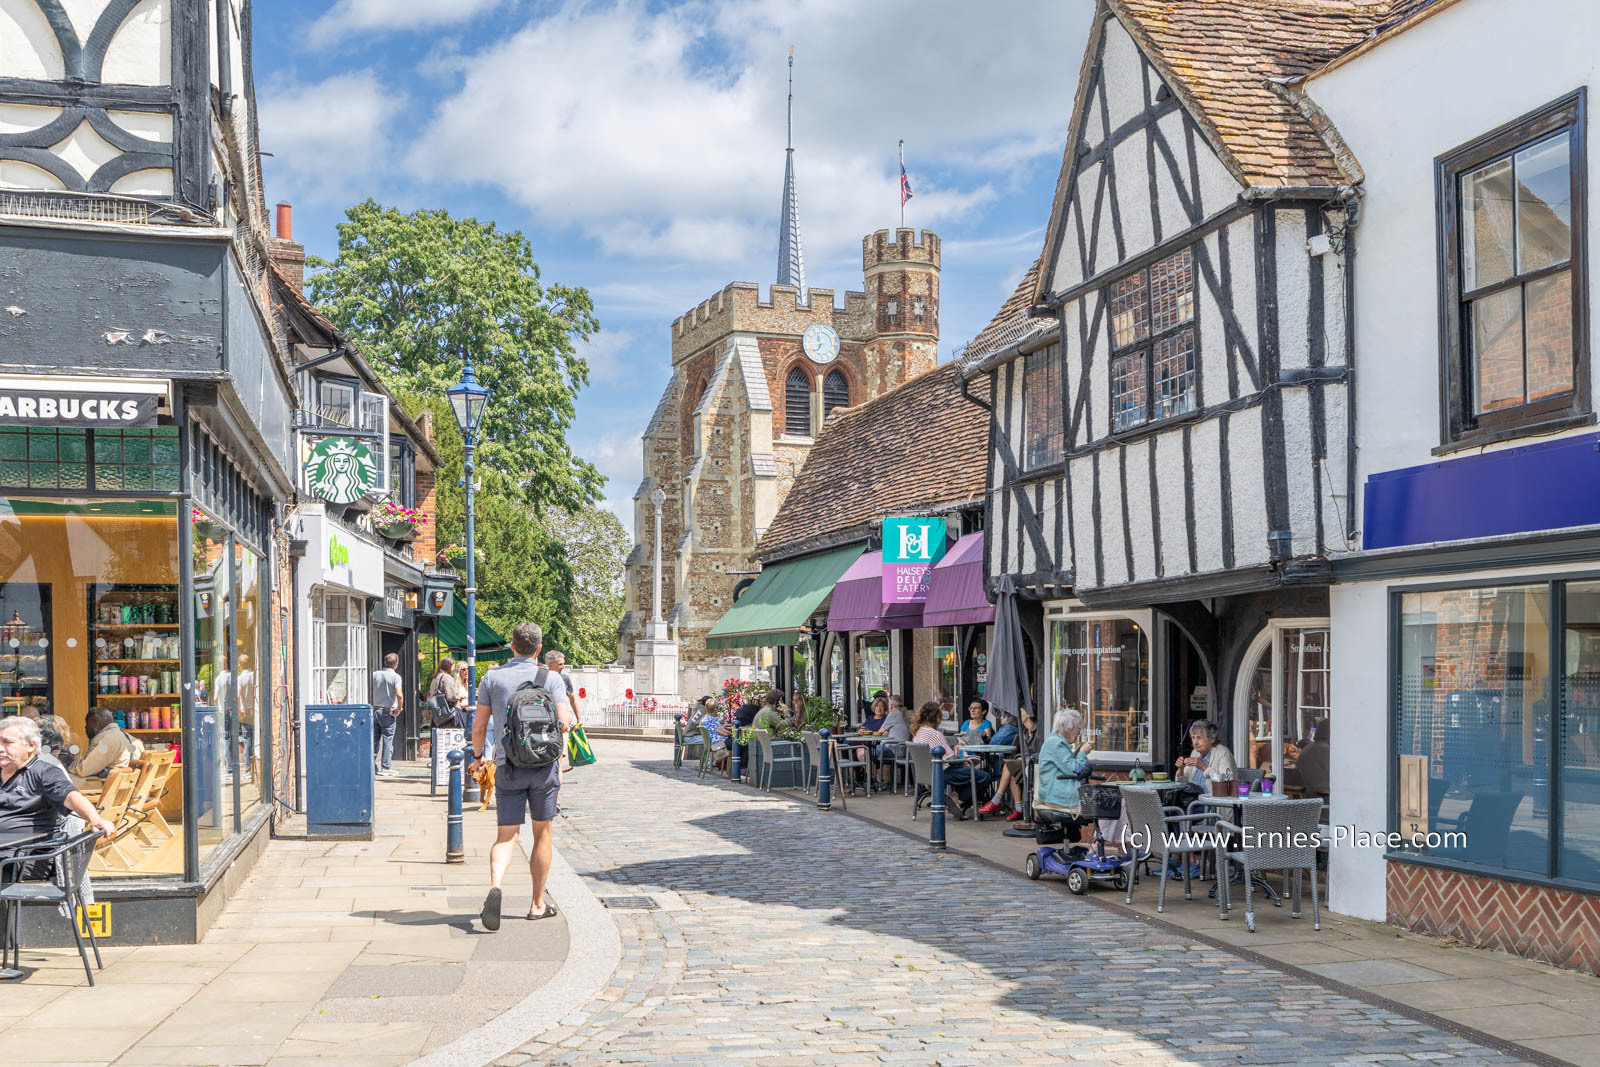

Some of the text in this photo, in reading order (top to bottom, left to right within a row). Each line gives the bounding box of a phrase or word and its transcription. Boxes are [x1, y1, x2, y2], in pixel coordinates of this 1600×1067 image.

[897, 567, 931, 575] HALSEY'S
[1291, 644, 1321, 652] Smothies
[1410, 823, 1419, 833] 12
